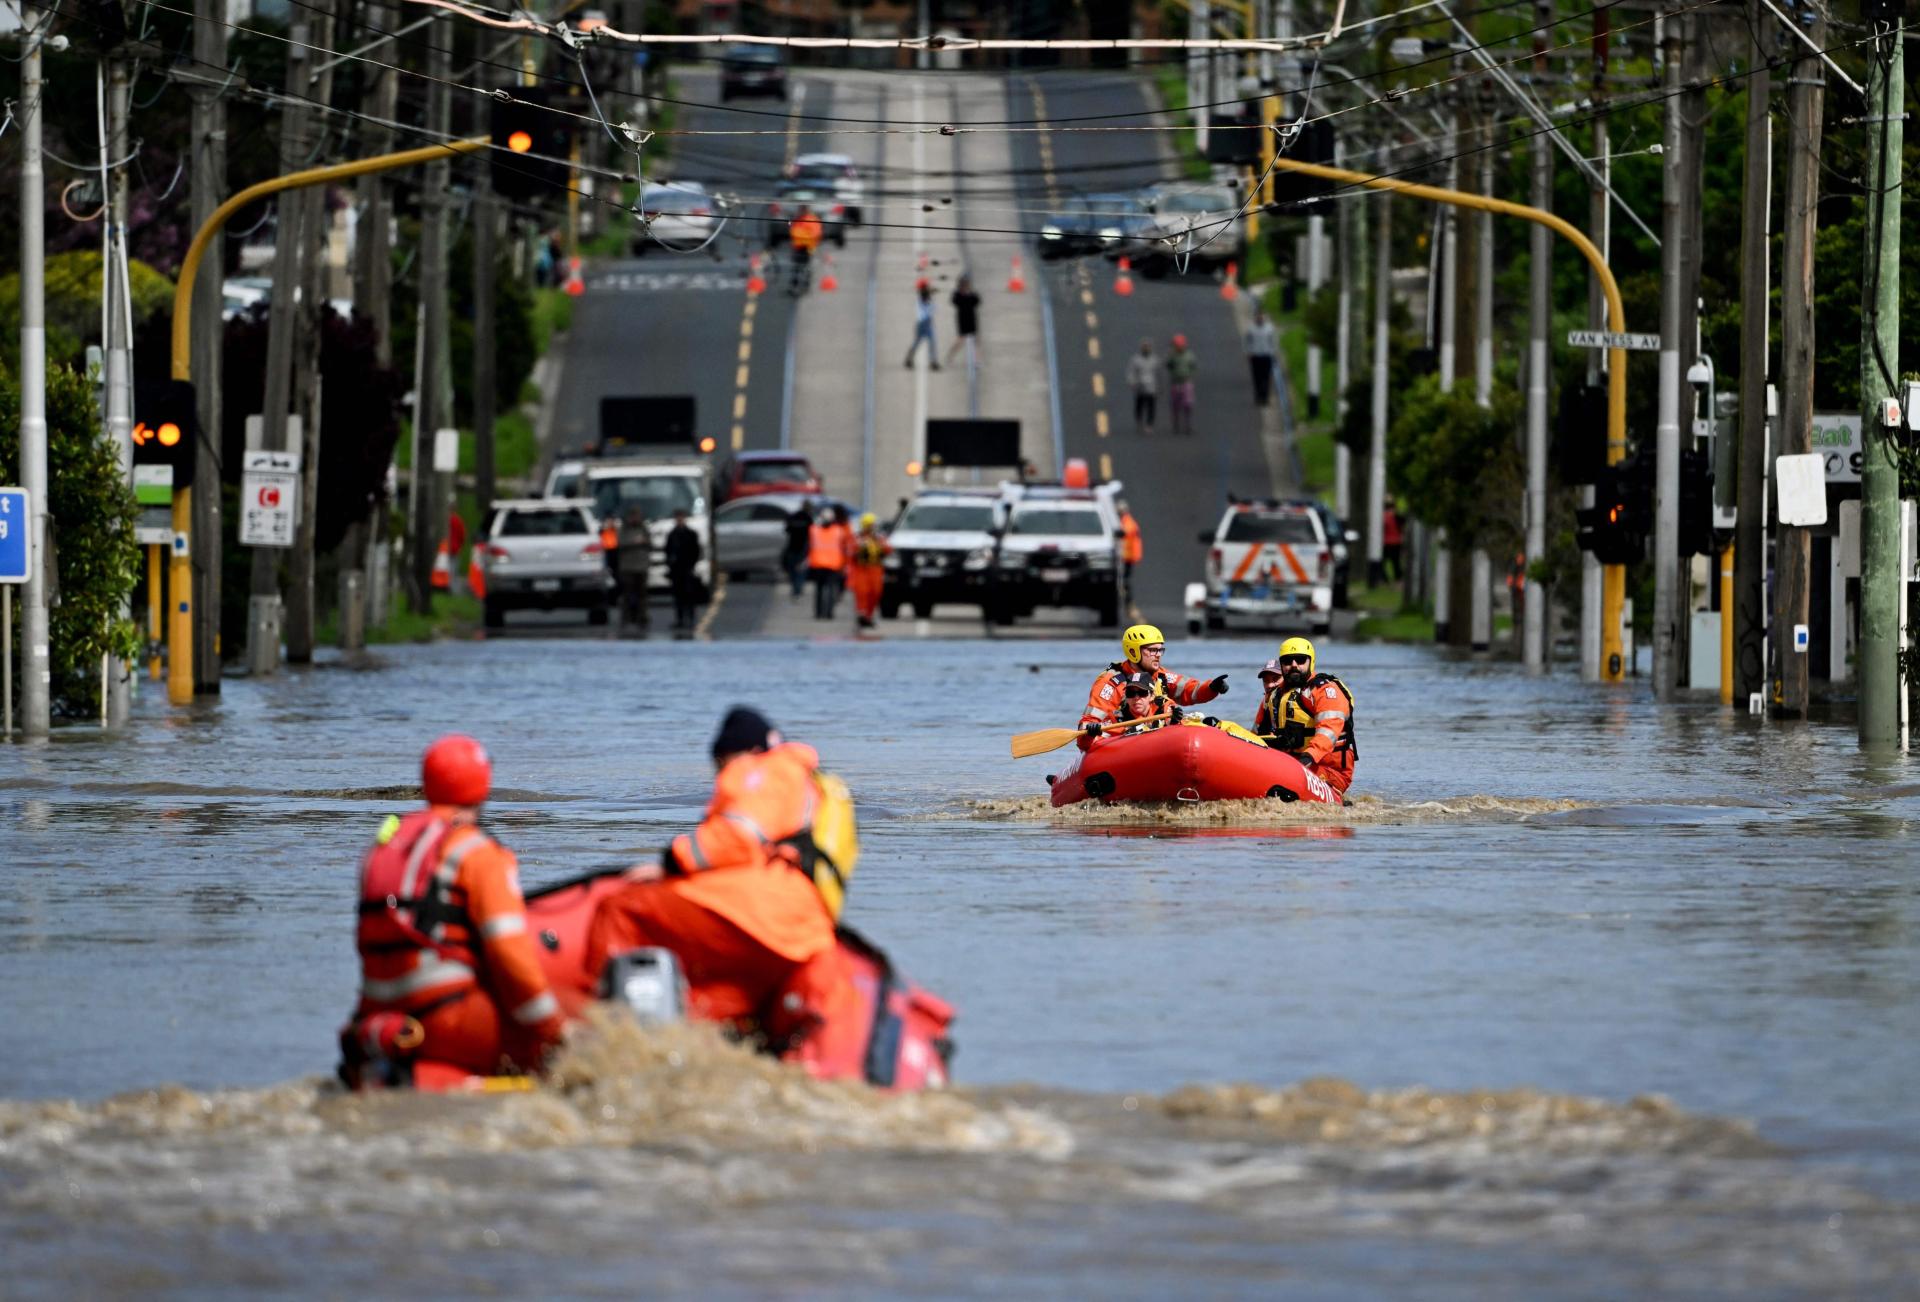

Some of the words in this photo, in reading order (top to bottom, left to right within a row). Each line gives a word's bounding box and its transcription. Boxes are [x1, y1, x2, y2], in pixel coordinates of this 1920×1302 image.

[1570, 332, 1595, 344] VAN
[1603, 333, 1633, 348] NESS
[1641, 335, 1657, 348] AV
